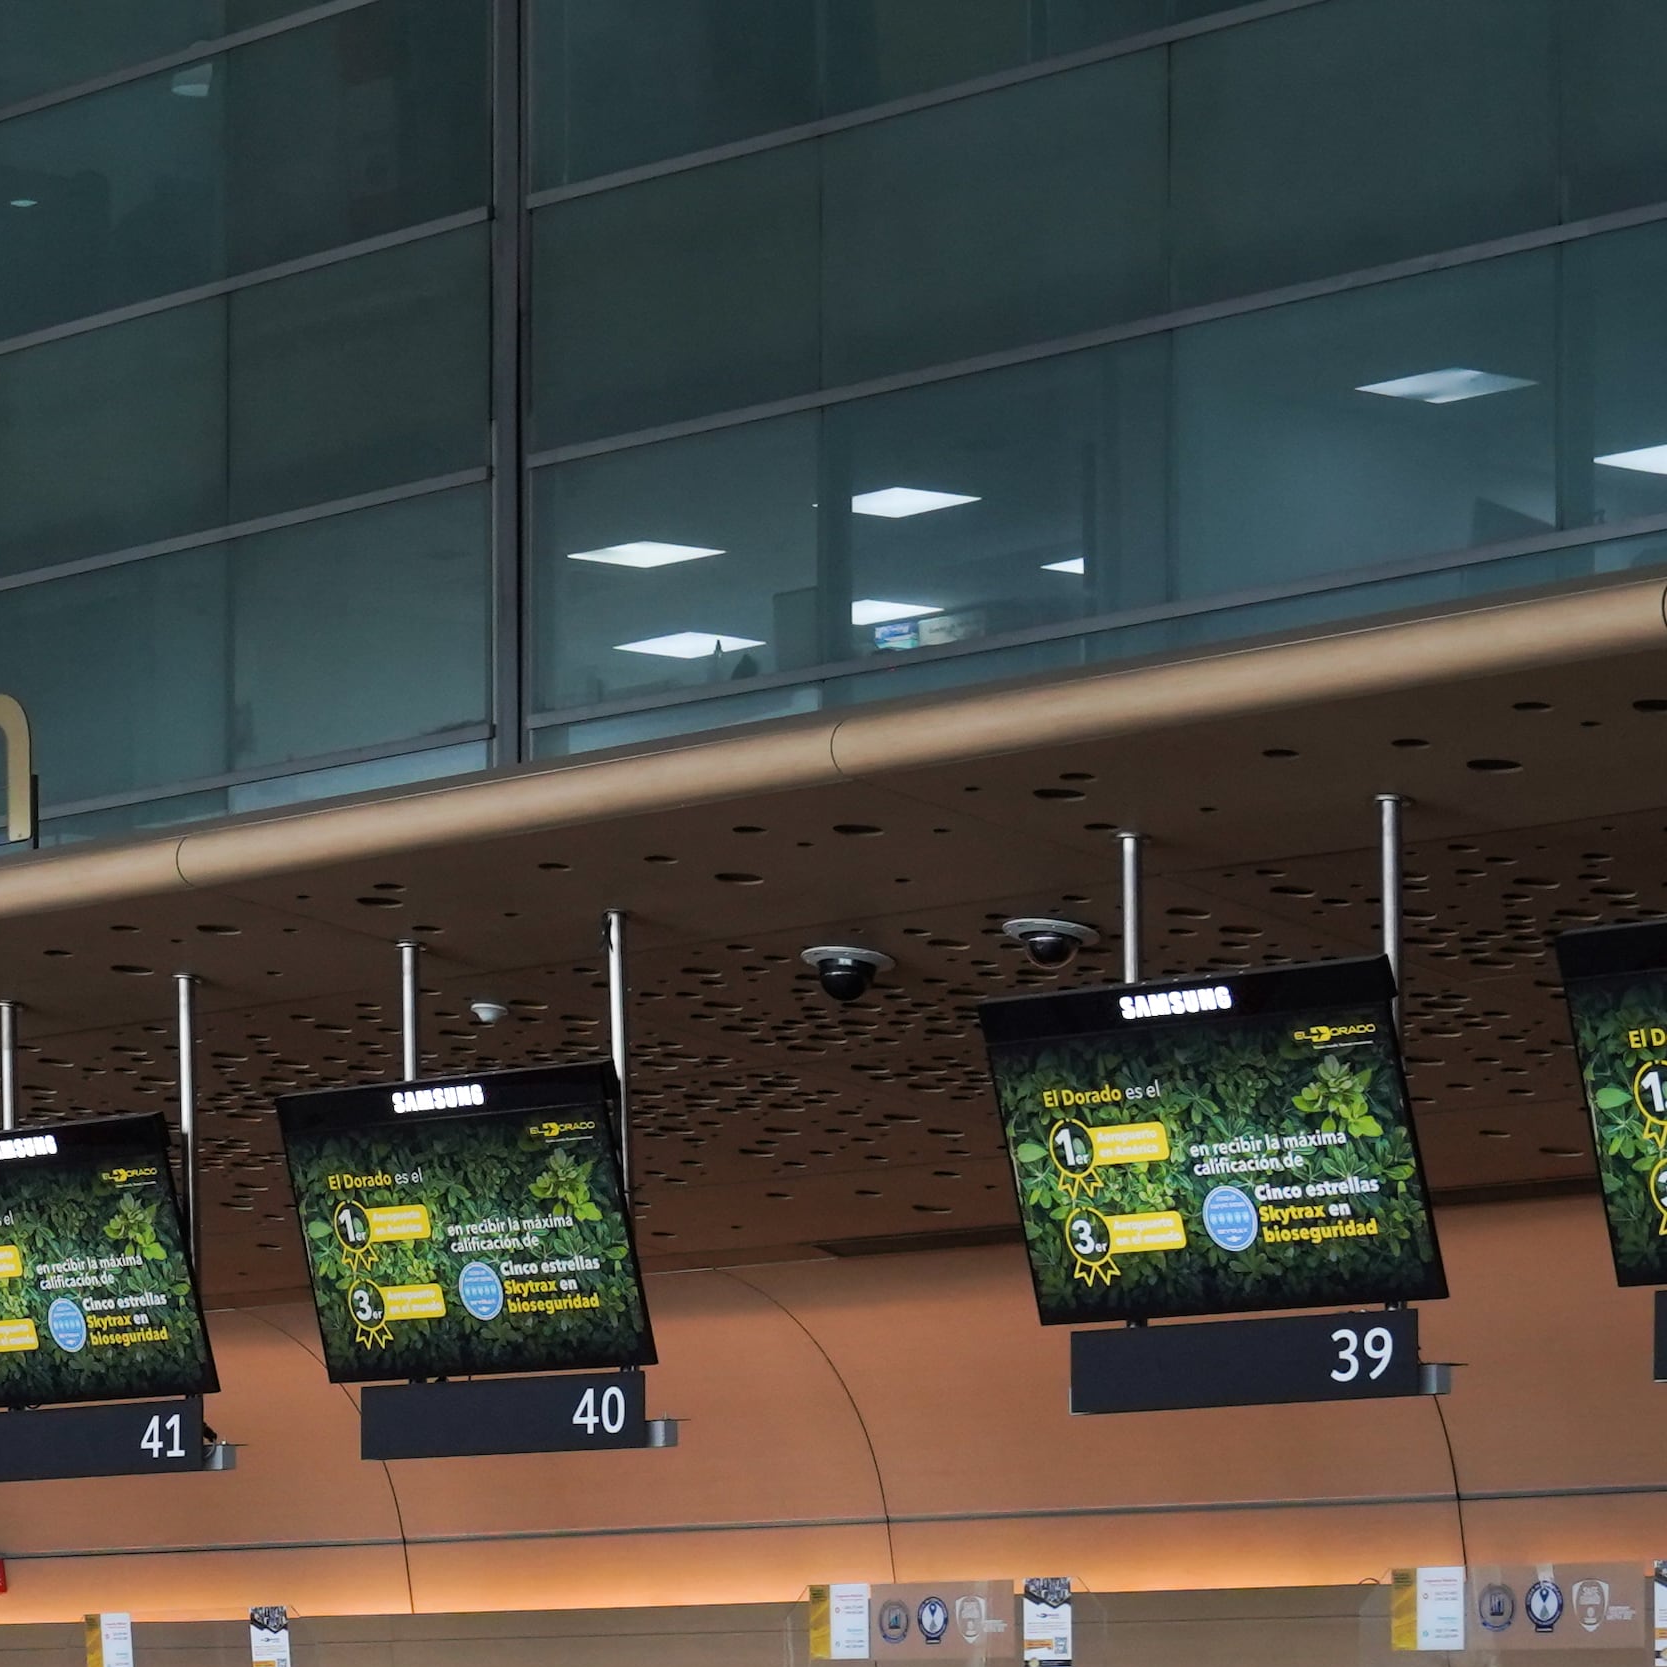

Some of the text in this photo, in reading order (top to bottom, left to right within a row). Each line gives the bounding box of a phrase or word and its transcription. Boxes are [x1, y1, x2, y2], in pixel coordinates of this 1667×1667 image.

[1119, 986, 1232, 1020] SAMSUNG
[392, 1084, 485, 1114] SAMSUNG
[1043, 1079, 1161, 1108] El Dorado es el
[1190, 1130, 1347, 1157] en recibir la máxima
[1193, 1151, 1304, 1176] calificación de
[328, 1167, 423, 1190] El Dorado es el
[1254, 1176, 1380, 1200] Cinco estrellas
[4, 1210, 14, 1225] el
[1259, 1202, 1351, 1225] Skytrax en
[447, 1224, 463, 1237] en
[466, 1218, 506, 1235] recibir
[508, 1216, 520, 1231] la
[1262, 1218, 1379, 1243] bioseguridad
[522, 1233, 539, 1248] de
[500, 1255, 600, 1276] Cinco estrellas
[503, 1278, 578, 1297] Skytrax en
[82, 1291, 167, 1311] Cinco estrellas
[507, 1292, 600, 1315] bioseguridad
[86, 1313, 149, 1330] Skytrax en
[90, 1326, 169, 1347] bioseguridad
[1331, 1328, 1394, 1382] 39
[572, 1386, 626, 1435] 40
[140, 1414, 186, 1458] 41
